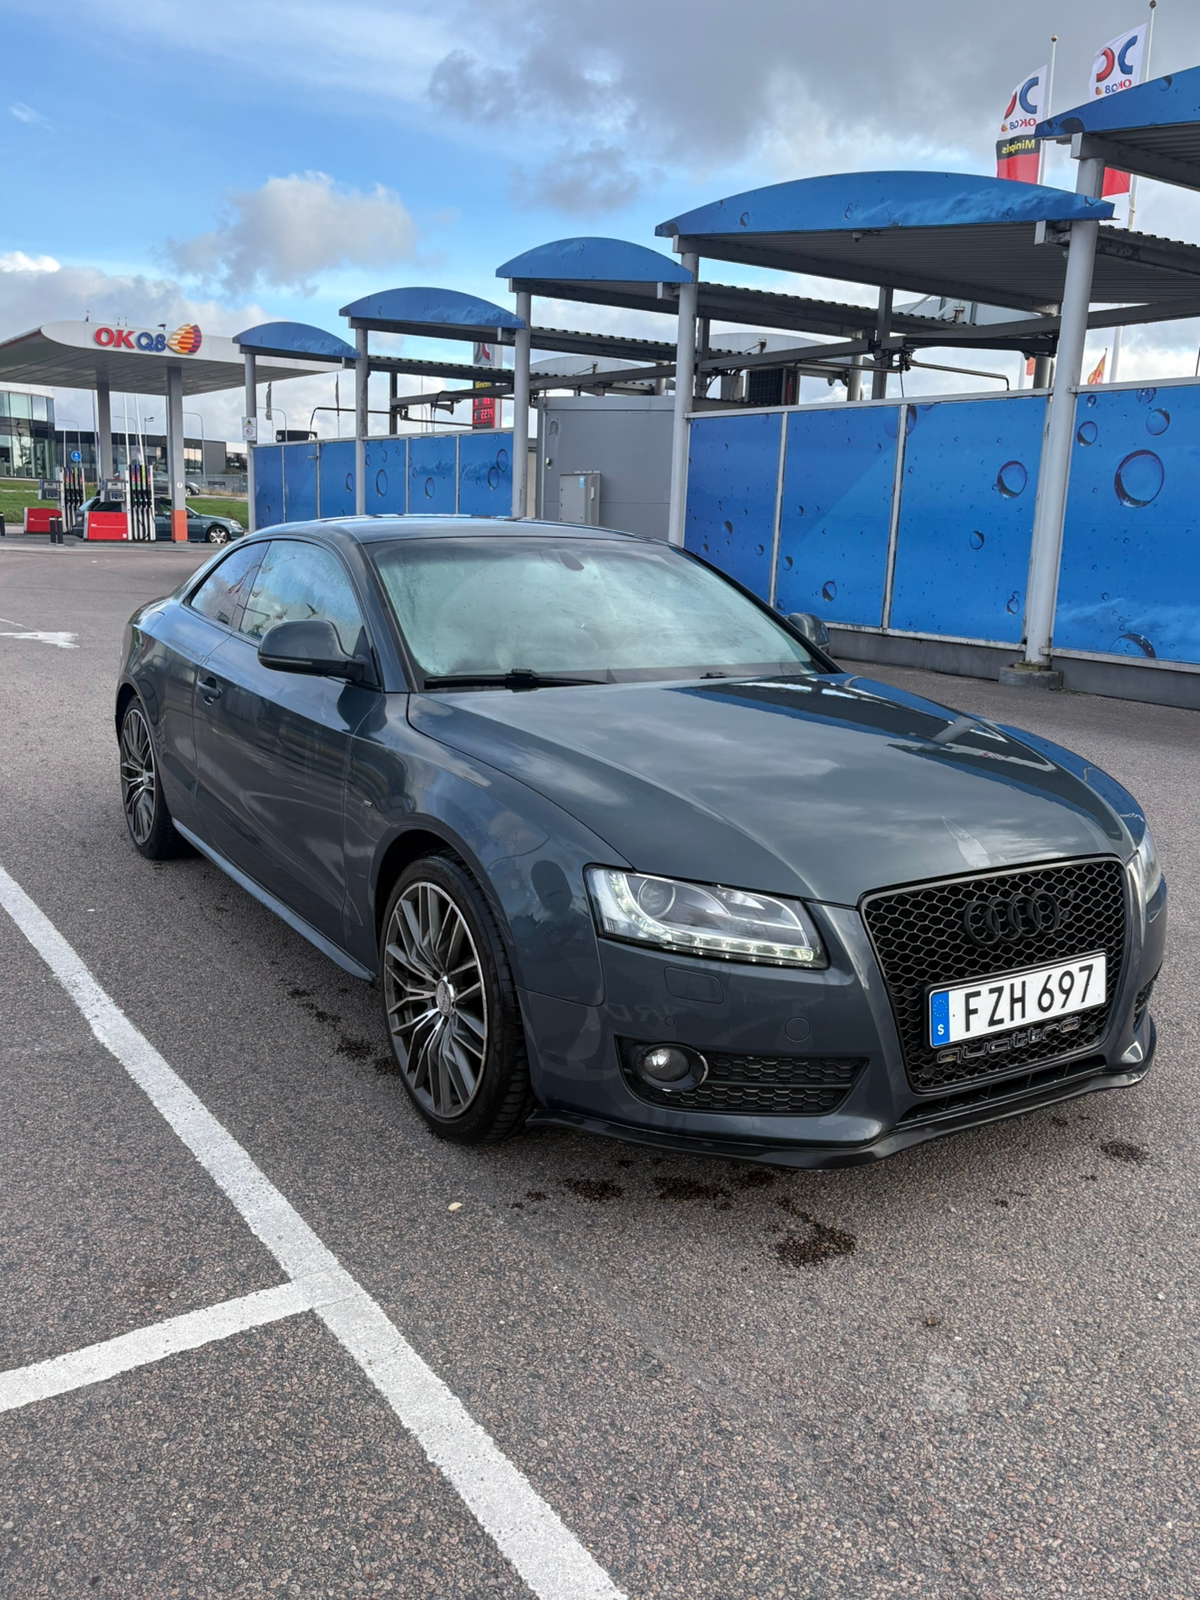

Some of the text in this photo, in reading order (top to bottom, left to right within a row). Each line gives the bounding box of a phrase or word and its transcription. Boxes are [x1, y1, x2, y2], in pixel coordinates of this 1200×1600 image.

[964, 963, 1094, 1033] FZH 697
[936, 1023, 945, 1036] S
[936, 1016, 1081, 1064] quattro
